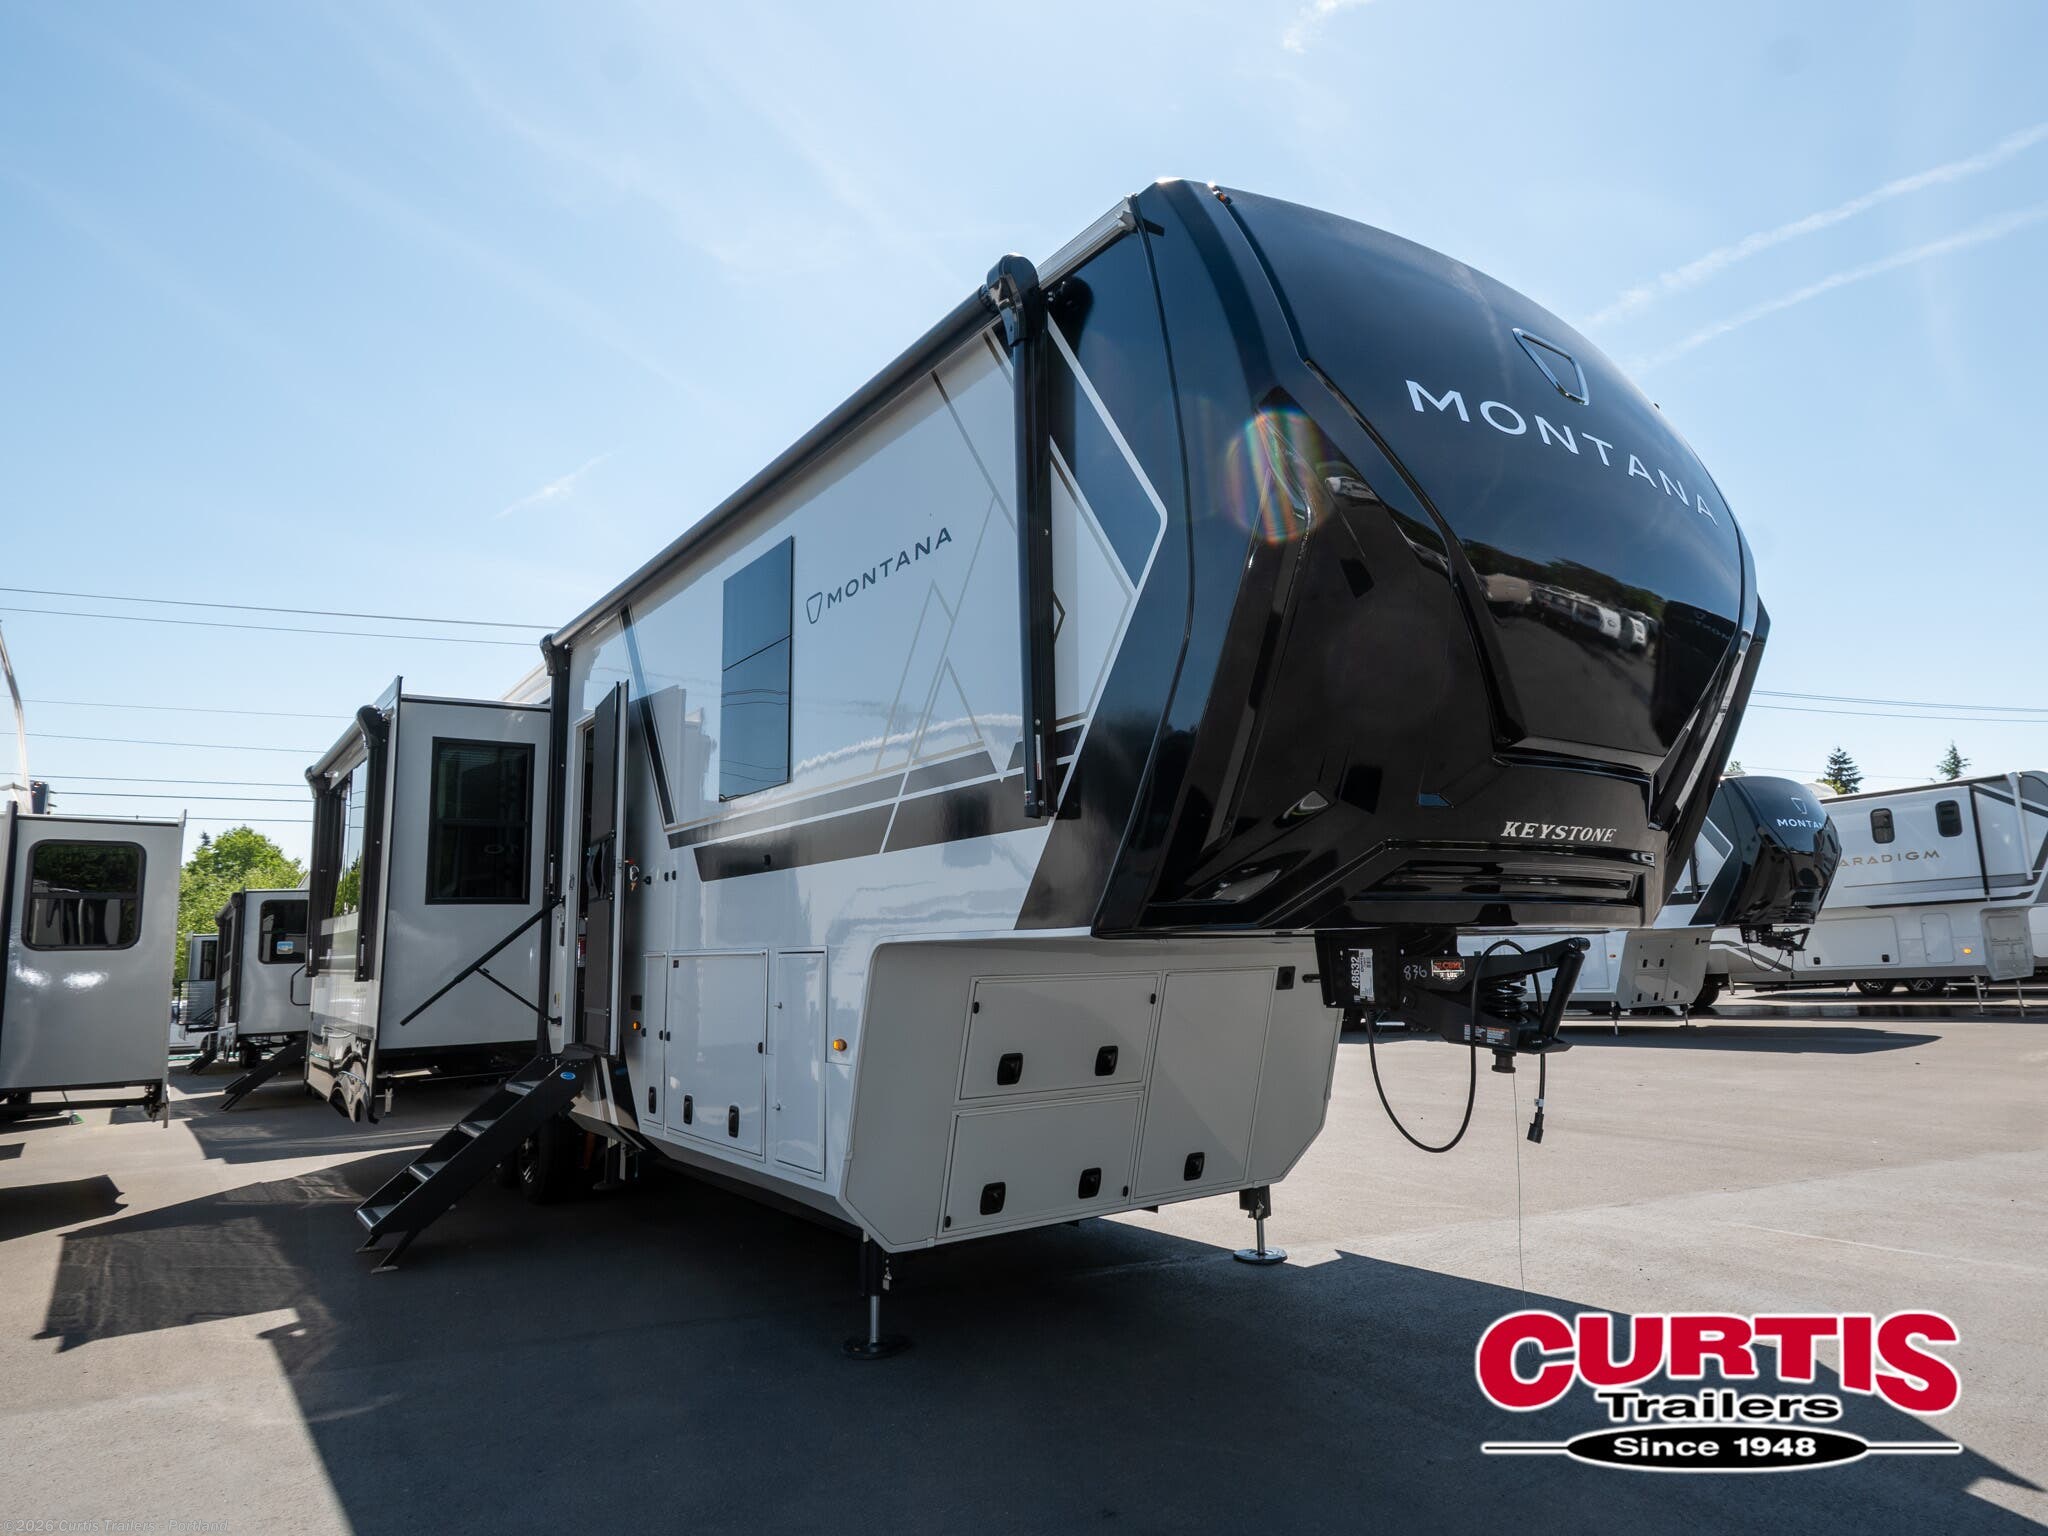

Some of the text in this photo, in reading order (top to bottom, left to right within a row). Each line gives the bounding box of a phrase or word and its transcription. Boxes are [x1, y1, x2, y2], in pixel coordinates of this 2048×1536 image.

[1405, 379, 1718, 527] MONTANA
[827, 527, 952, 608] MONTANA
[1500, 820, 1617, 843] KEYSTONE
[1776, 818, 1823, 829] MONTA
[1839, 850, 1940, 867] ARADIGM
[1350, 956, 1360, 989] 48632
